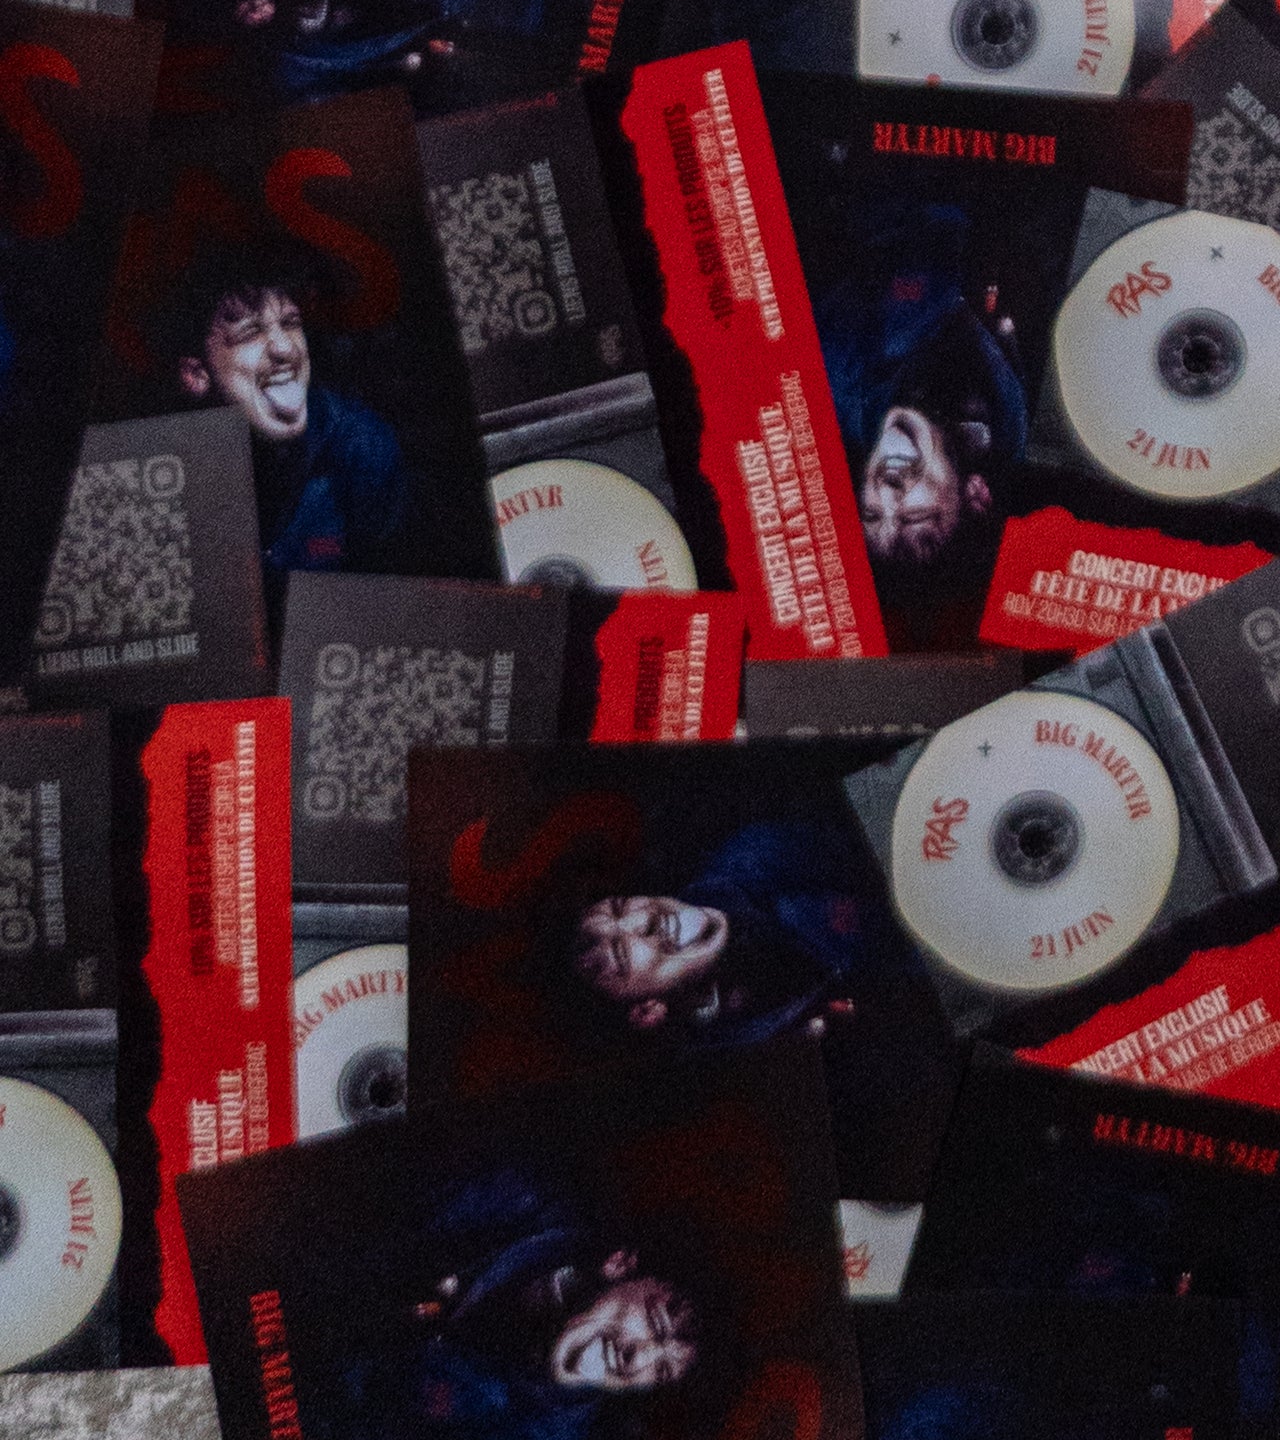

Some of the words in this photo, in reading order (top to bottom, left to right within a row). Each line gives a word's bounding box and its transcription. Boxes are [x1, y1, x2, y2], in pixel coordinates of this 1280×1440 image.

[872, 121, 996, 159] MARTYR
[1003, 133, 1056, 163] BIG
[1104, 260, 1173, 318] RAS
[1126, 430, 1156, 458] 21
[1153, 443, 1211, 472] JUIN
[1032, 720, 1078, 749] BIG
[1079, 732, 1153, 822] MARTYR
[919, 797, 970, 863] RAS
[1029, 936, 1058, 961] 21
[1061, 911, 1115, 957] JUIN
